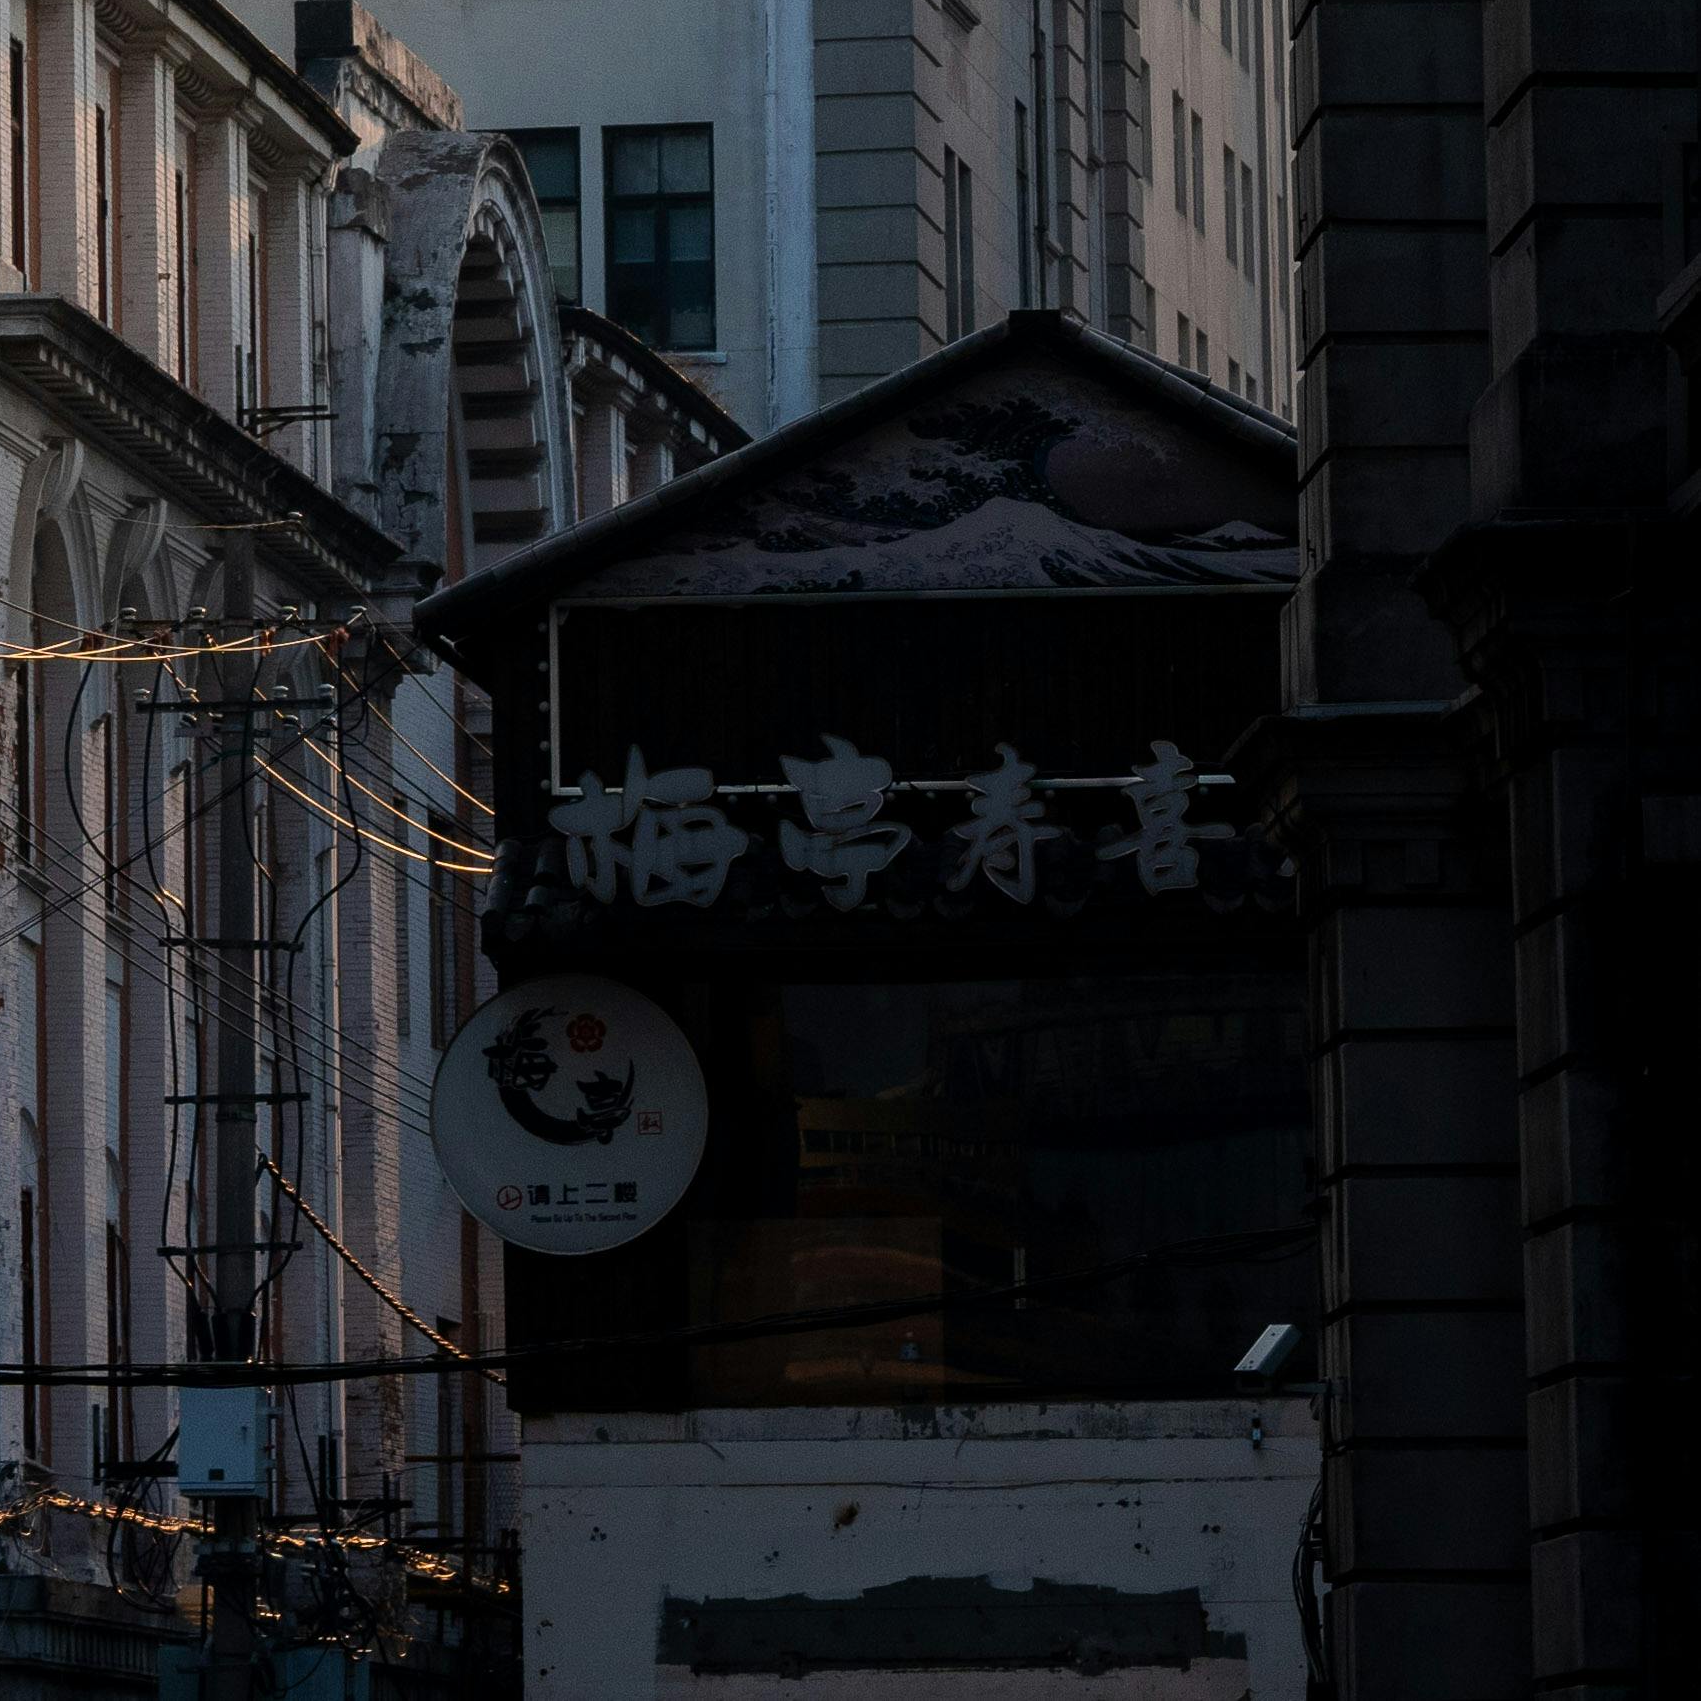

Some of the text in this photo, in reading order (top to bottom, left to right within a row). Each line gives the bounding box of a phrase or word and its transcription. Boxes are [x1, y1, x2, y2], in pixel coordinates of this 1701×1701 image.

[554, 1214, 563, 1223] Go
[563, 1214, 573, 1224] Up
[574, 1213, 583, 1222] To
[584, 1213, 596, 1222] The
[598, 1212, 620, 1222] Second
